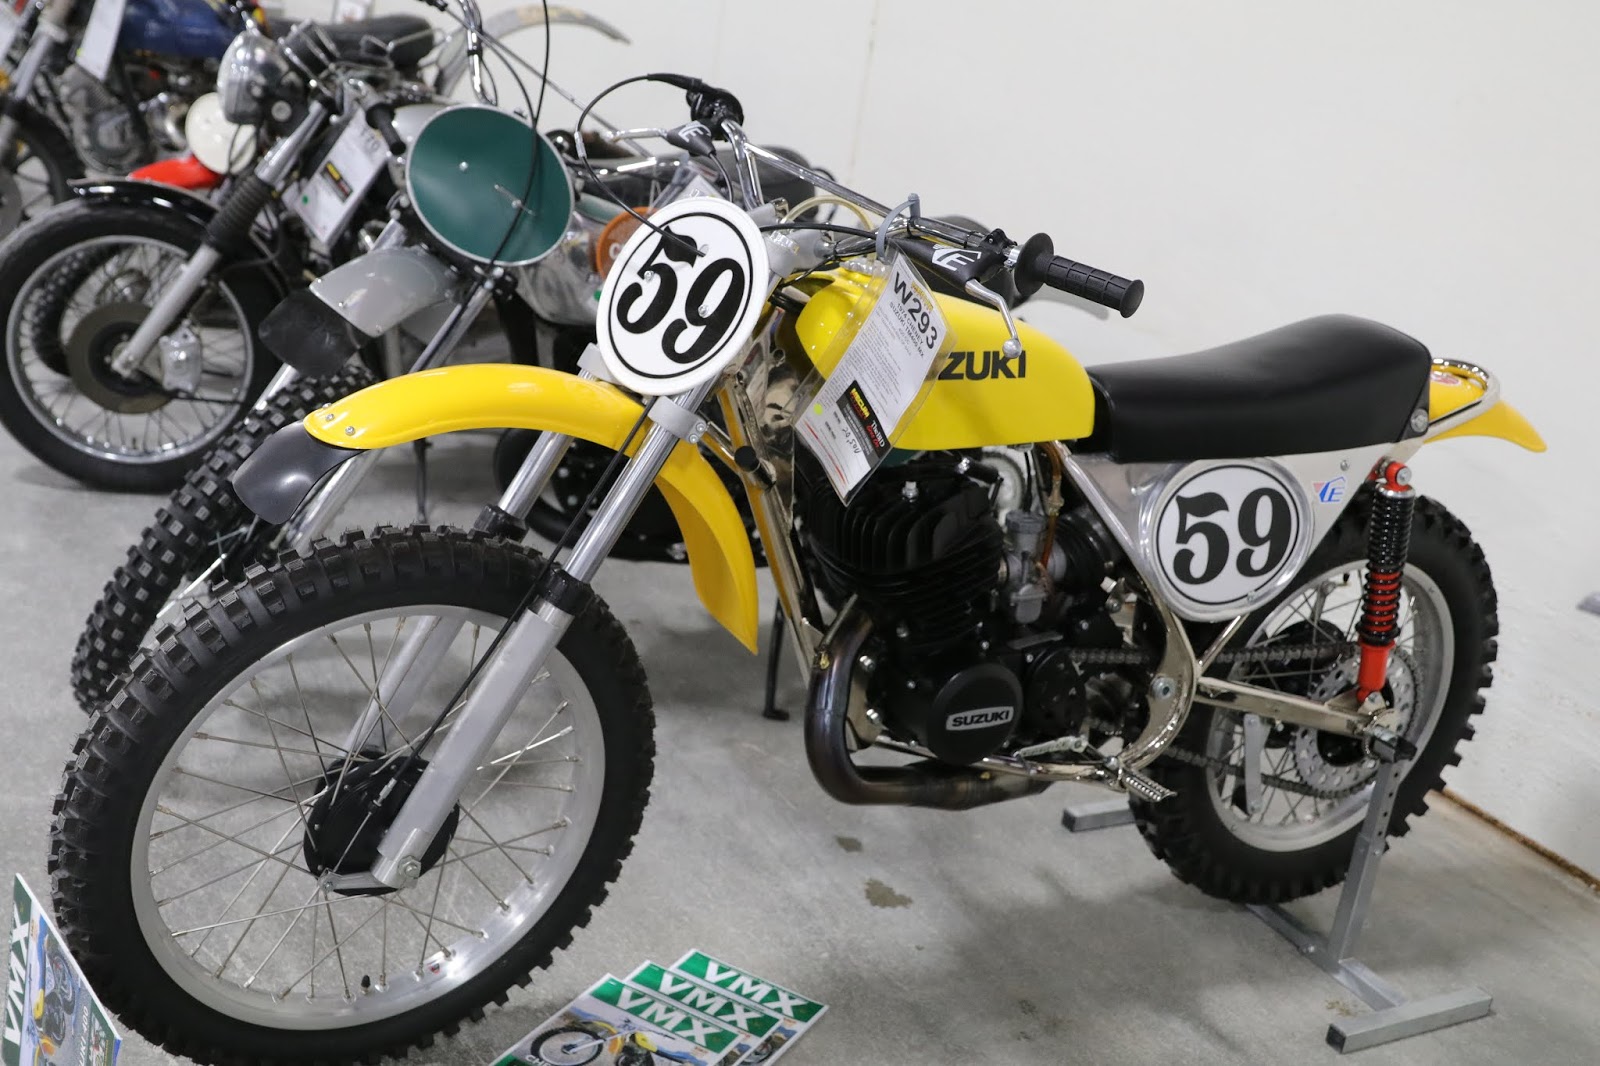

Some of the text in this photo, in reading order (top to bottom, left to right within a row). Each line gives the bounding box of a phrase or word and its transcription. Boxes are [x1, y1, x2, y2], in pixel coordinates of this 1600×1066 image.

[617, 225, 745, 364] 59
[889, 301, 905, 327] SUZUKI
[894, 271, 938, 349] W293
[906, 317, 924, 345] CHENEY
[935, 350, 1027, 381] ZUKI
[1173, 487, 1292, 585] 59
[951, 710, 1010, 727] SUZUKI
[4, 902, 31, 1046] VMX
[658, 971, 765, 1032] VMX
[705, 961, 808, 1018] VMX
[616, 987, 724, 1048] VMX
